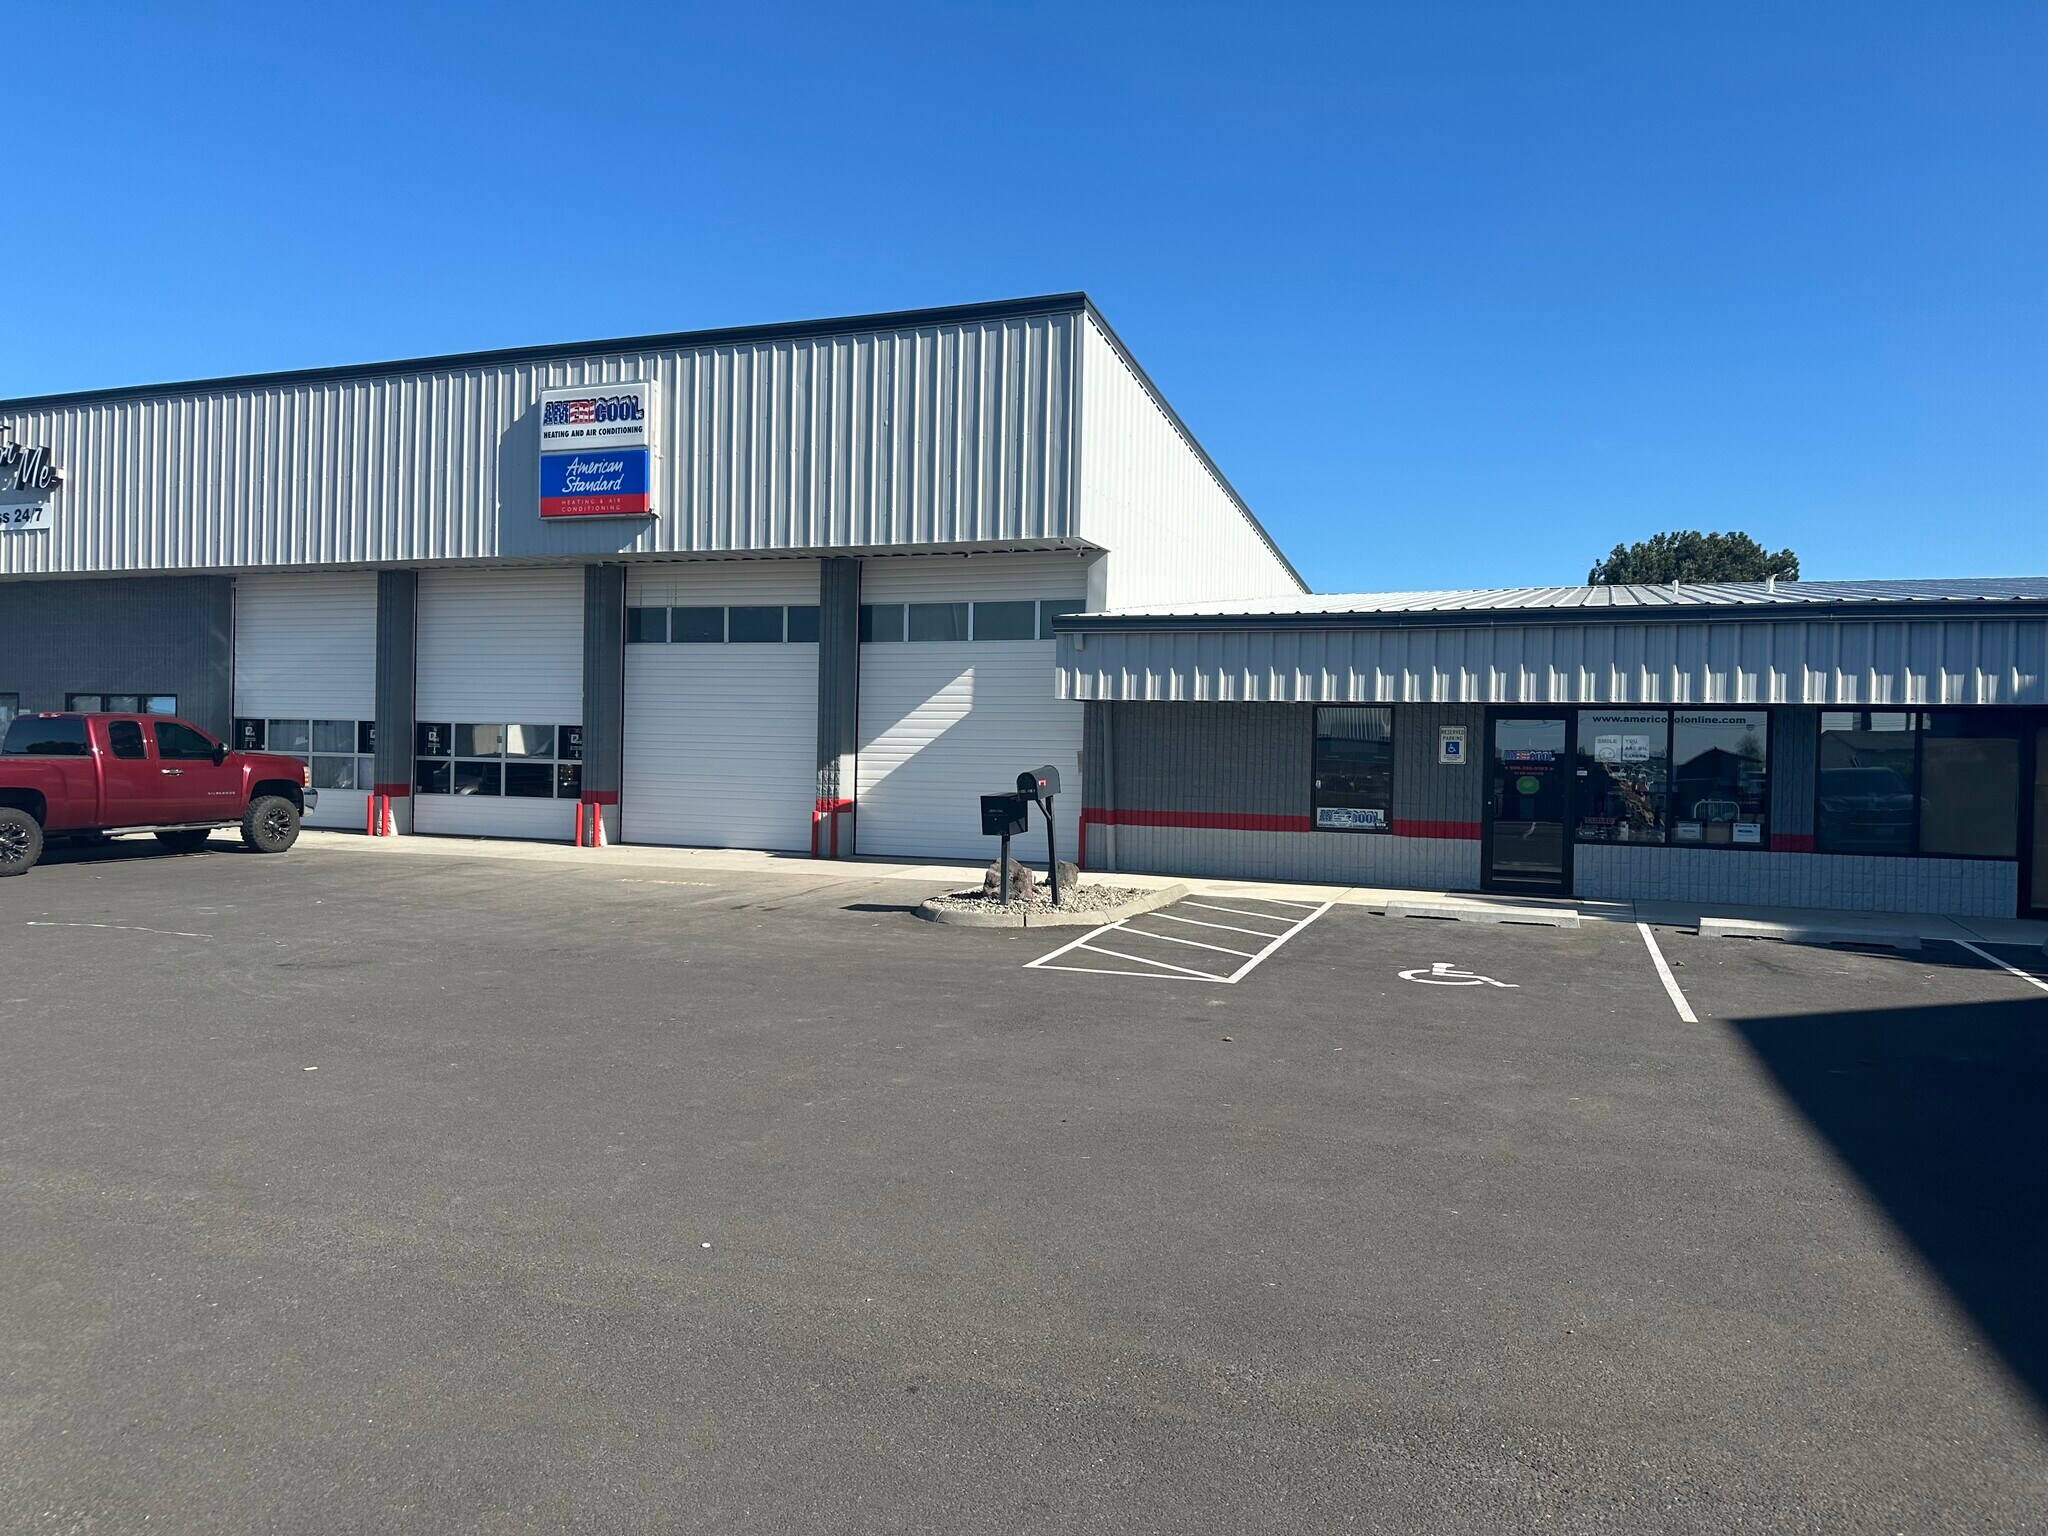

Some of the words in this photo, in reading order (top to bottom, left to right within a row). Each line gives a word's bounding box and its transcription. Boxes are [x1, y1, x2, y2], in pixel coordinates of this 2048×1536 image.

[543, 394, 644, 426] AMERICOOL
[543, 430, 569, 439] HEATING
[571, 428, 584, 437] AND
[586, 428, 597, 436] AIR
[598, 425, 643, 436] CONDITIONING
[13, 446, 51, 489] Me
[566, 457, 624, 476] American
[562, 473, 625, 493] Standard
[14, 508, 43, 523] 24/7
